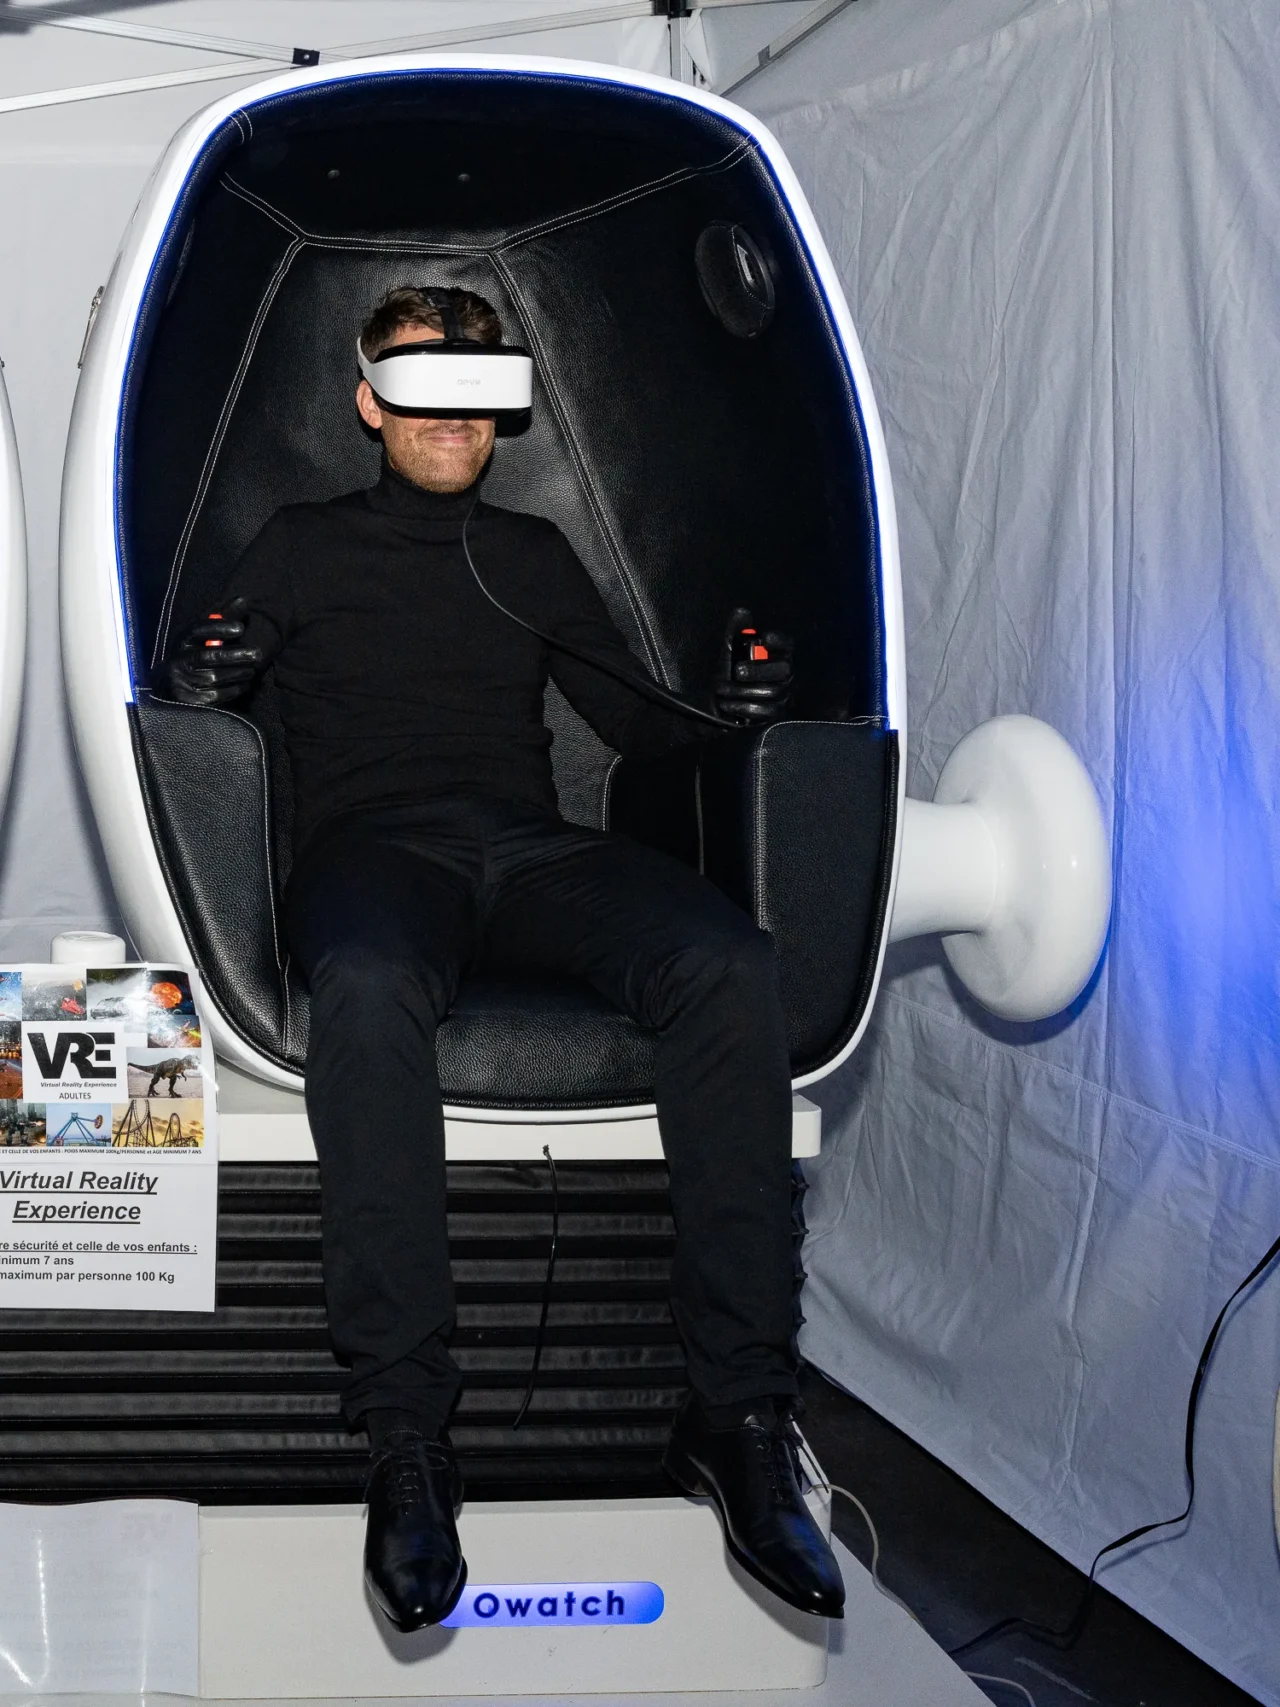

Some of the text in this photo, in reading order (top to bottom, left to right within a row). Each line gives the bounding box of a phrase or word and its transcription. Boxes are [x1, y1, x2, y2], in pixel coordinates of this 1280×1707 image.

[27, 1032, 117, 1079] VRE
[59, 1092, 92, 1100] ADULTES
[0, 1170, 159, 1195] Virtual Reality
[12, 1200, 141, 1223] Experience
[12, 1240, 59, 1253] sécurité
[61, 1242, 74, 1251] et
[76, 1241, 103, 1251] celle
[106, 1241, 120, 1252] de
[123, 1243, 144, 1252] vos
[147, 1242, 190, 1253] enfants
[43, 1256, 50, 1265] 7
[53, 1258, 75, 1266] ans
[56, 1273, 75, 1282] par
[77, 1273, 132, 1284] personne
[135, 1272, 155, 1282] 100
[158, 1272, 175, 1284] Kg
[473, 1590, 624, 1618] Owatch
